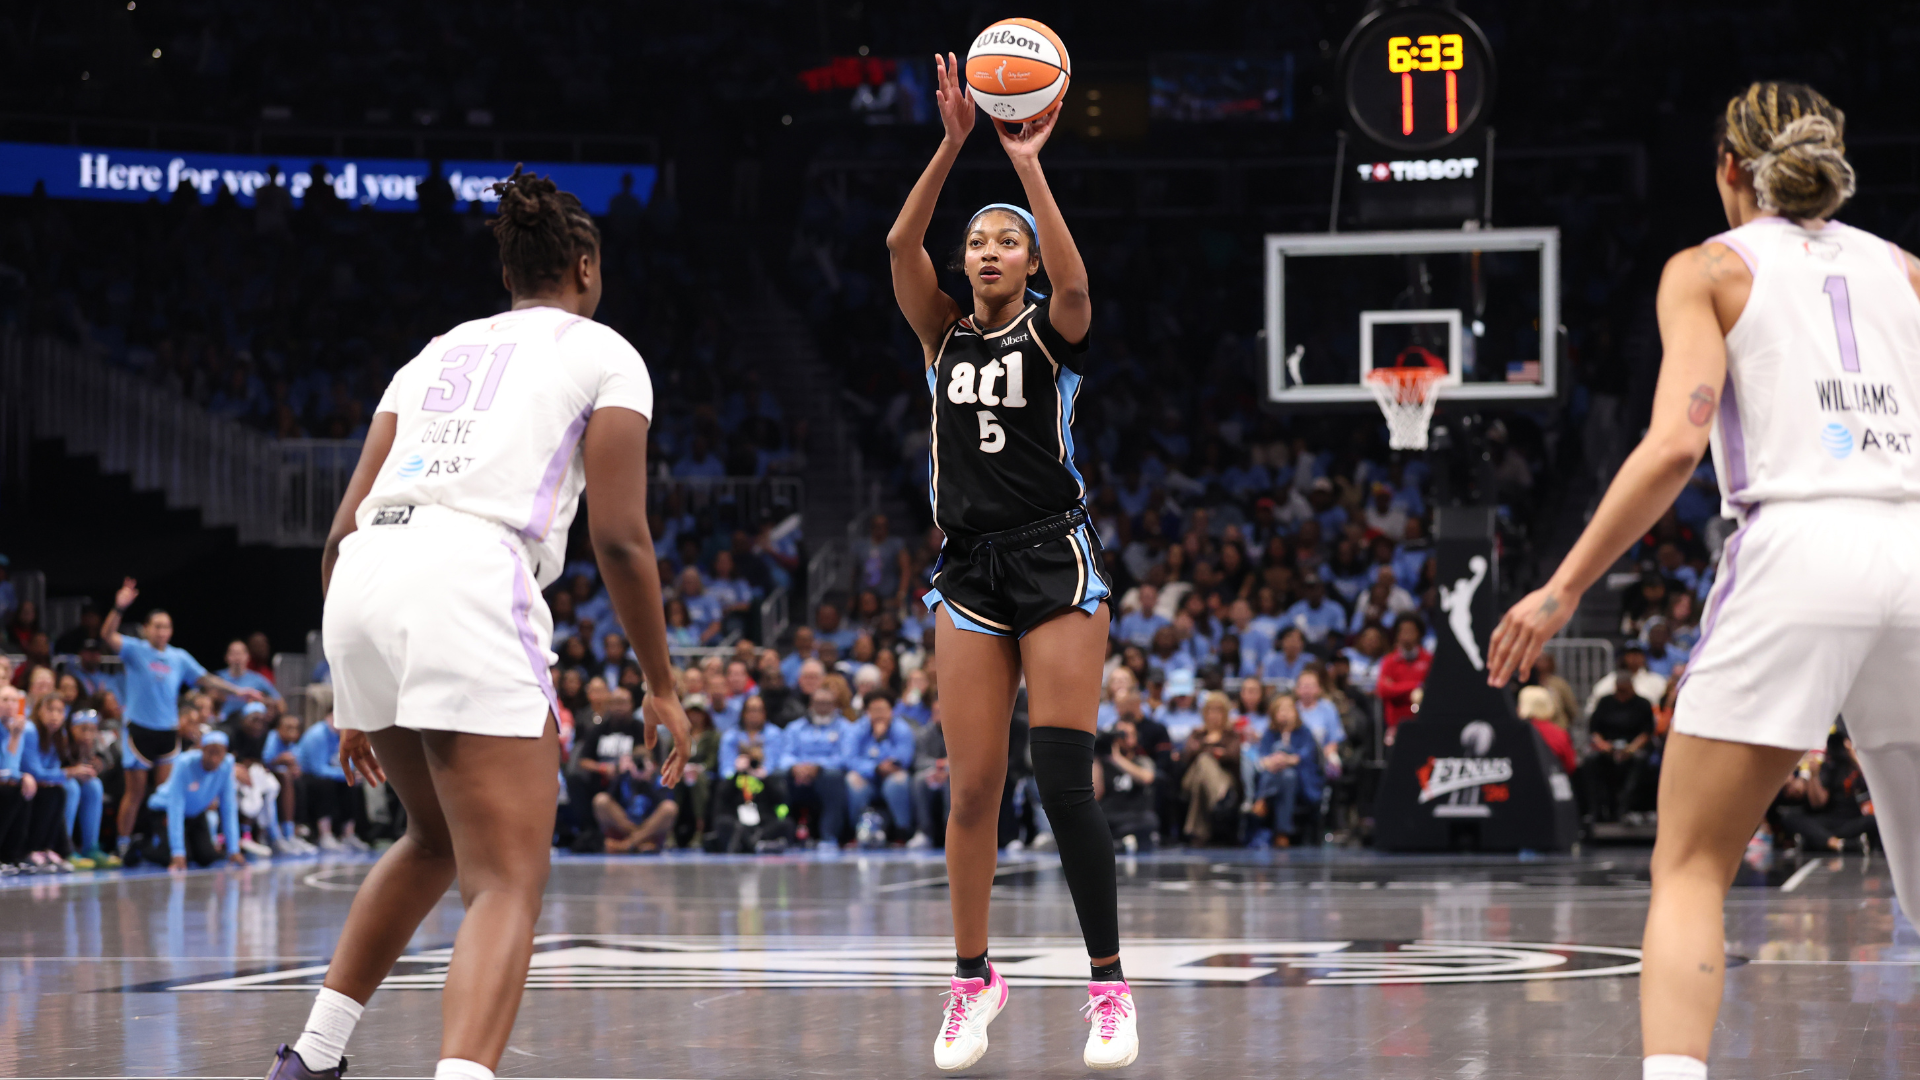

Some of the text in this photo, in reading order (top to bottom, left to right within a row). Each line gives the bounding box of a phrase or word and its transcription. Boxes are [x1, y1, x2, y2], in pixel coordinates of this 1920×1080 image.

[977, 30, 1040, 53] Wilson
[1388, 34, 1464, 73] 6:33
[79, 153, 163, 192] Here
[290, 162, 357, 201] ad
[362, 173, 426, 206] you
[449, 170, 516, 203] tea
[1000, 332, 1029, 347] Albert
[1823, 275, 1860, 373] 1
[421, 343, 517, 413] 31
[947, 350, 1028, 408] atl
[421, 419, 476, 445] GUEYE
[976, 410, 1006, 454] 5
[425, 456, 476, 477] AT&T
